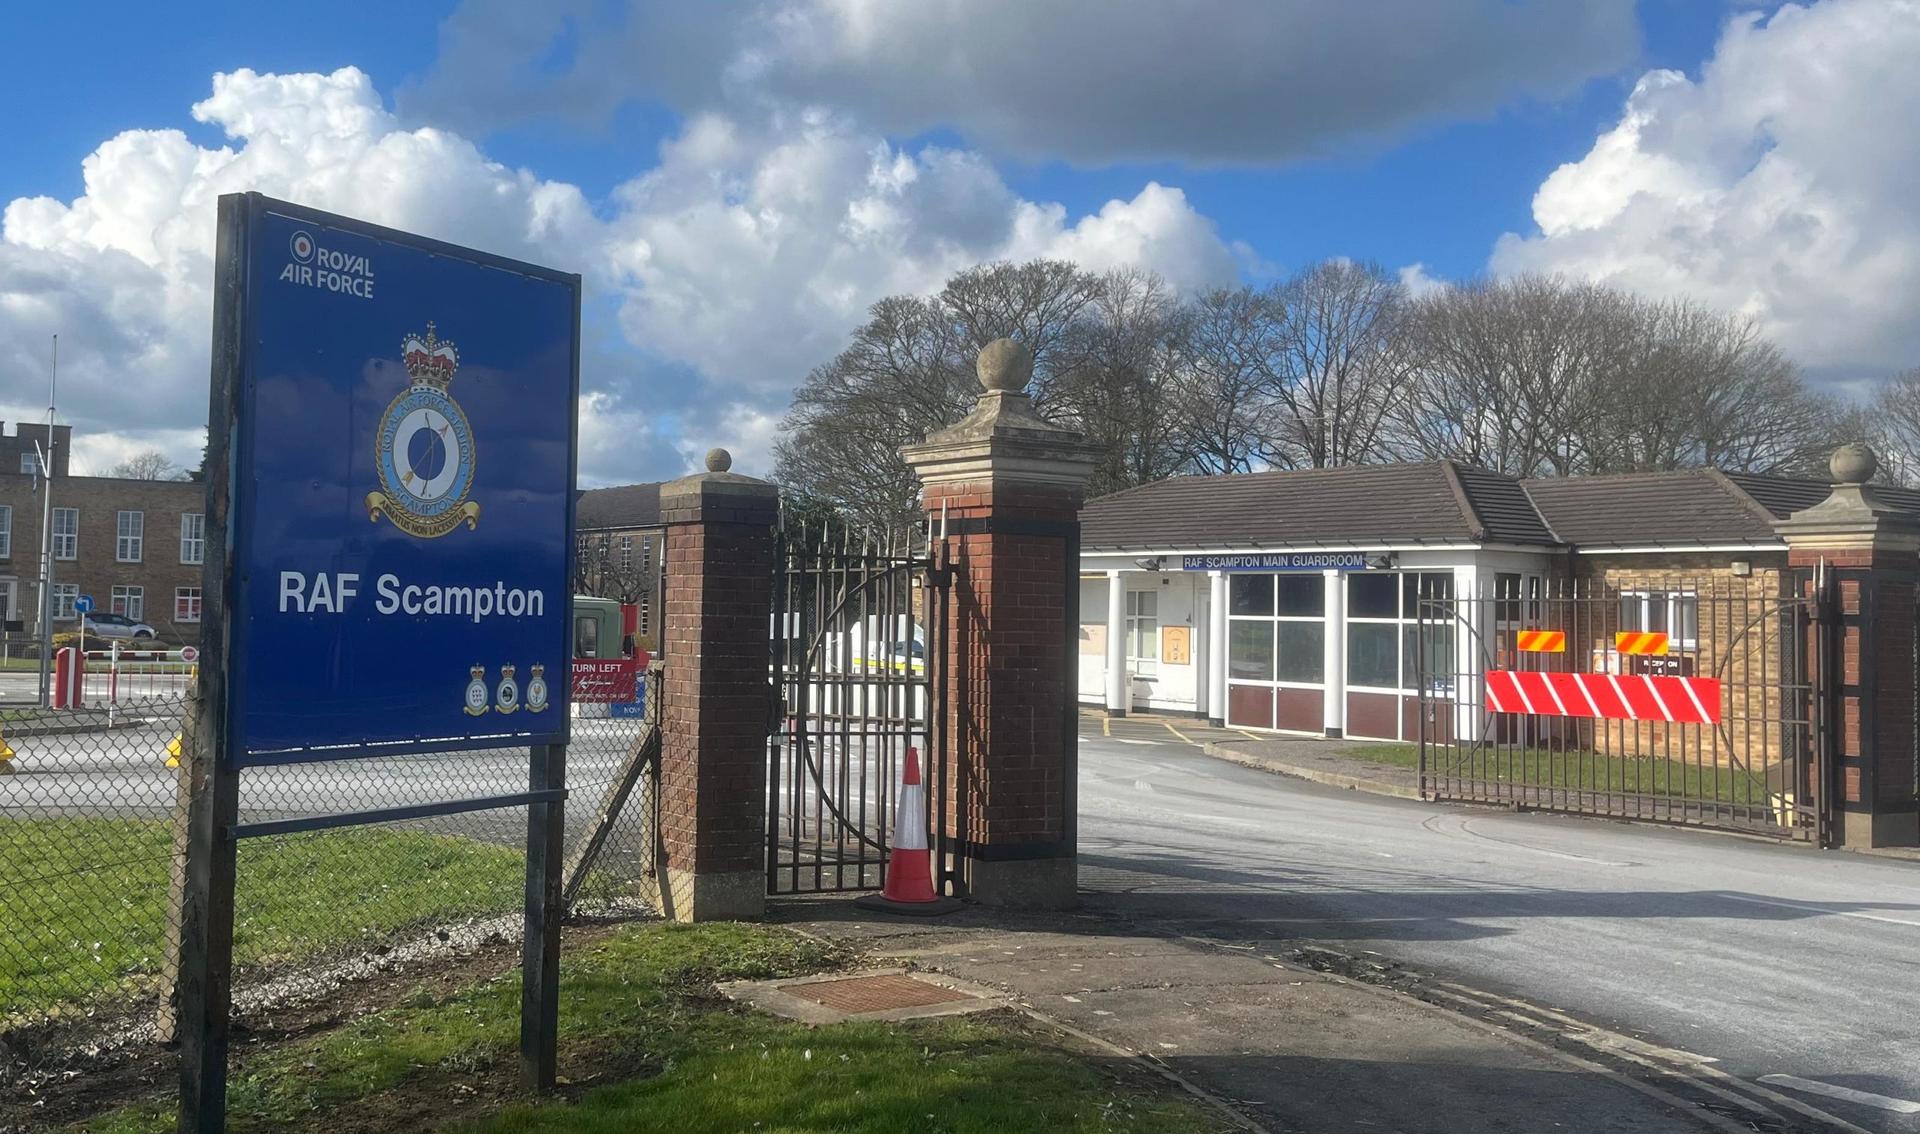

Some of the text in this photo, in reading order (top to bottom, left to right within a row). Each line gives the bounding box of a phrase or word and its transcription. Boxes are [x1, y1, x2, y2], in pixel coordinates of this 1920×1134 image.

[317, 247, 374, 277] ROYAL
[279, 263, 374, 299] AIR FORCE
[383, 415, 400, 453] ROYAL
[1184, 554, 1363, 568] RAF SCAMPTON MAIN GUARDROOM
[279, 571, 544, 623] RAF Scampton
[572, 663, 622, 673] TURN LEFT
